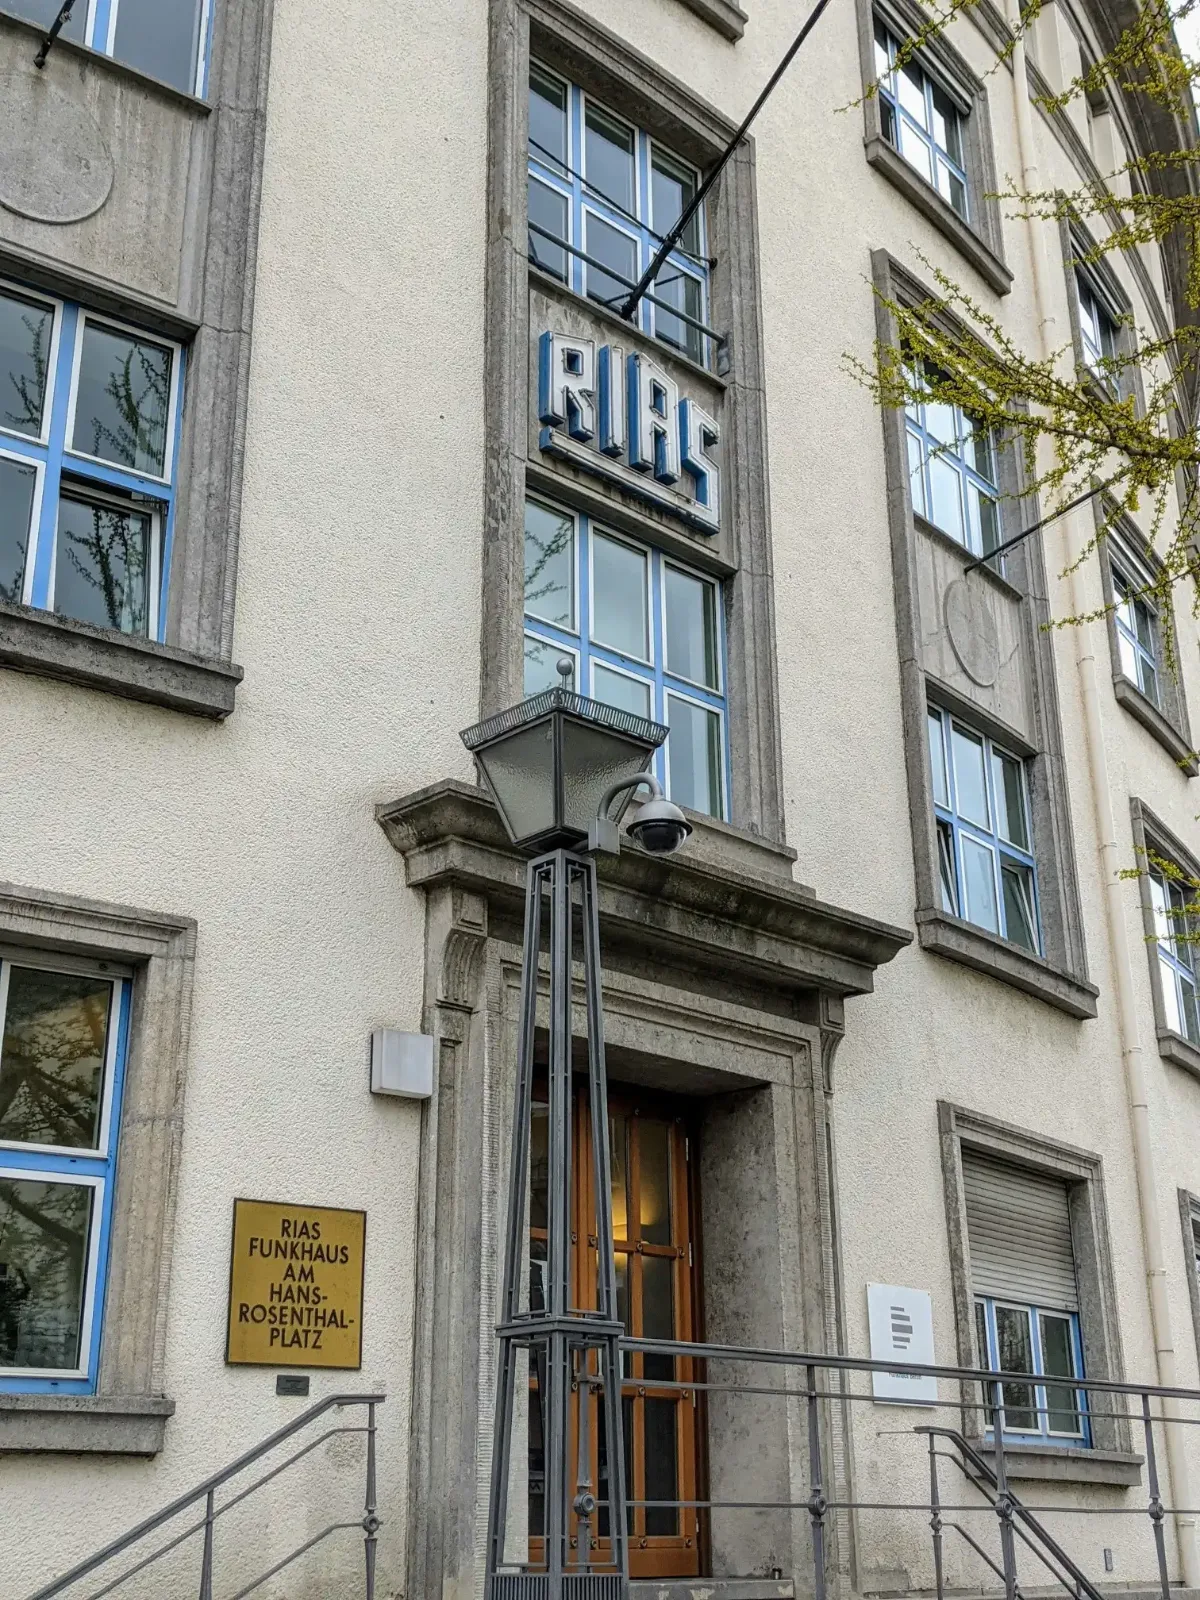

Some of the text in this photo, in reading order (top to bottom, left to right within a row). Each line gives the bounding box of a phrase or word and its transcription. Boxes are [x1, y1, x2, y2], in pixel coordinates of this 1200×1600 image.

[538, 330, 721, 537] RIAS
[281, 1218, 321, 1240] RIAS
[249, 1237, 349, 1264] FUNKHAUS
[283, 1262, 315, 1283] AM
[269, 1283, 328, 1305] HANS-
[239, 1303, 354, 1329] ROSENTHAL-
[269, 1327, 323, 1349] PLATZ
